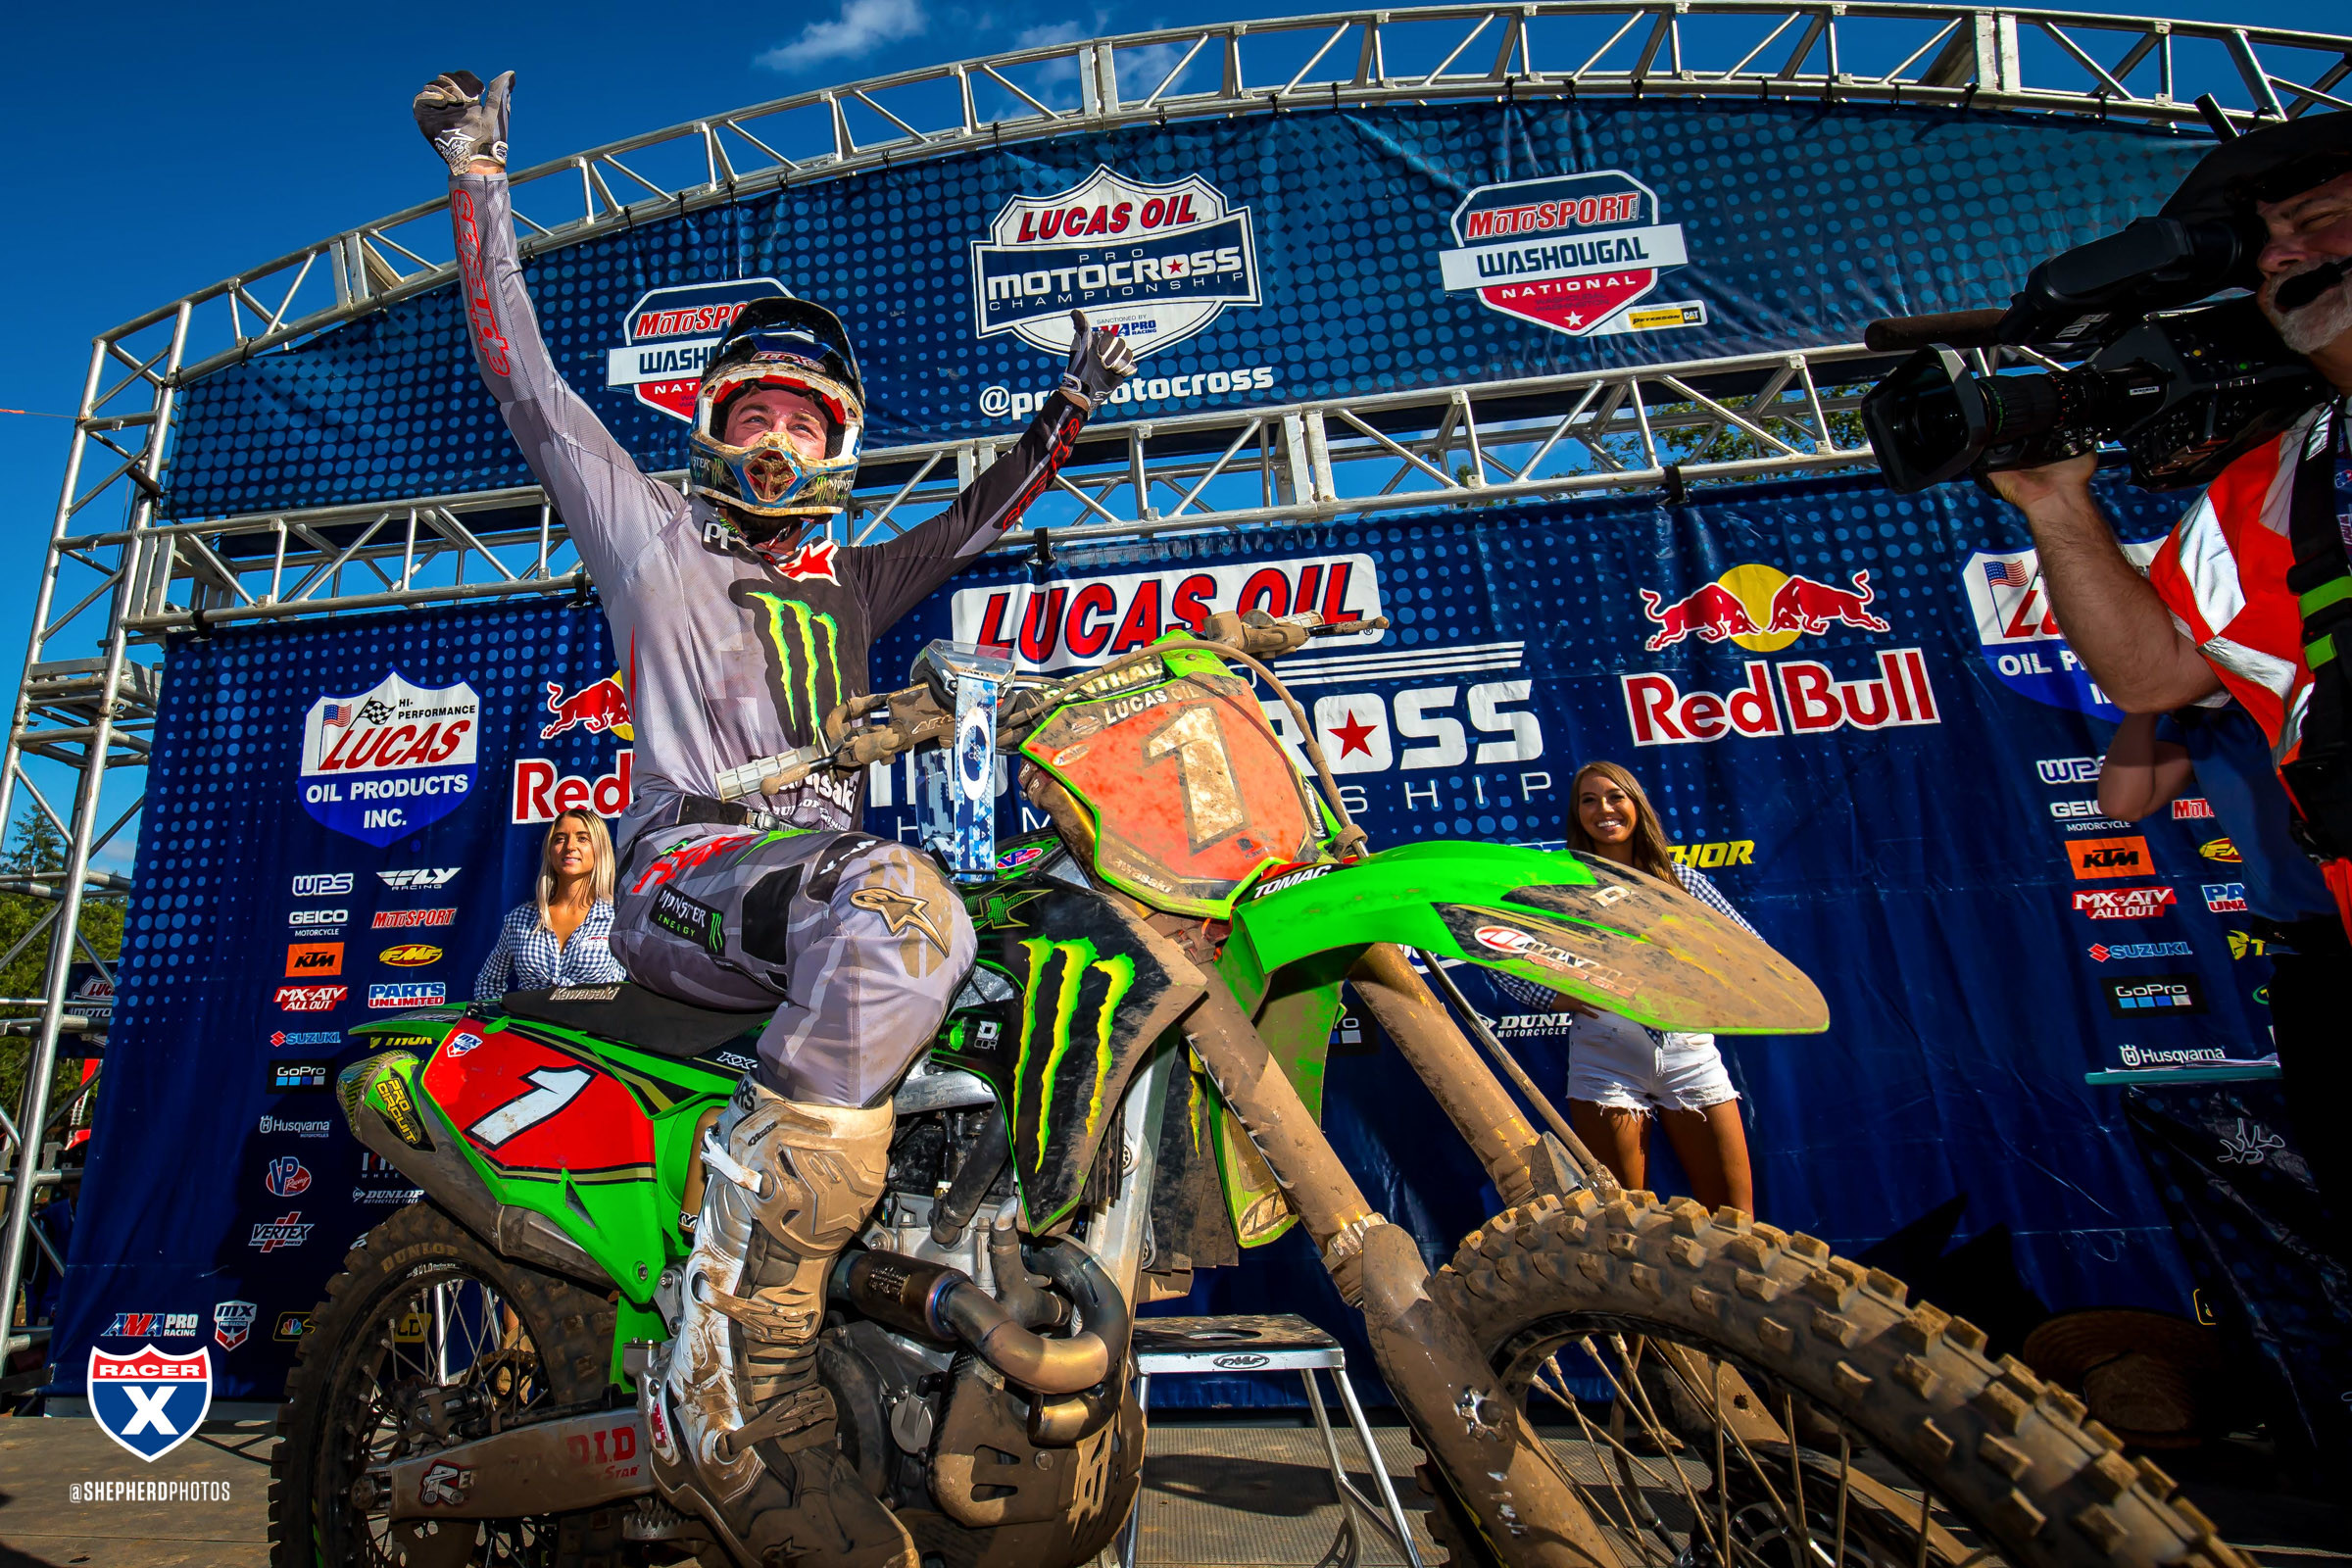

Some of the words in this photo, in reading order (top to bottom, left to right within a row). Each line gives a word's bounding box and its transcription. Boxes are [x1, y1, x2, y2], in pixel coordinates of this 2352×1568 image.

[1016, 202, 1133, 243] LUCAS
[1141, 194, 1198, 228] OIL
[1079, 248, 1144, 263] PRO
[1477, 236, 1649, 278] WASHOUGAL
[987, 246, 1243, 300] MOTOCROSS
[989, 271, 1244, 313] CHAMPIONSHIP
[1500, 275, 1637, 299] NATIONAL
[1096, 315, 1137, 325] SANCTIONED
[1130, 319, 1156, 330] PRO
[1633, 314, 1681, 325] PETERSON
[1683, 310, 1699, 320] CAT
[980, 367, 1275, 419] @protocross
[976, 573, 1218, 664] LUCAS
[1236, 562, 1365, 627] OIL
[1997, 653, 2052, 676] OIL
[398, 698, 414, 708] HI-
[1621, 661, 1785, 747] Red
[1776, 647, 1941, 734] Bull
[397, 705, 476, 719] PERFORMANCE
[1103, 688, 1168, 726] LUCAS
[318, 719, 471, 770] LUCAS
[513, 749, 634, 824] Red
[1144, 704, 1248, 851] 1
[306, 783, 342, 804] OIL
[350, 773, 468, 801] PRODUCTS
[363, 808, 408, 829] INC.
[2066, 820, 2132, 832] MOTORCYCLE
[2082, 848, 2138, 868] KTM
[292, 872, 354, 897] WPS
[375, 867, 463, 887] FLY
[1253, 864, 1332, 900] TOMAC
[2075, 891, 2115, 909] MX
[2124, 888, 2173, 906] ATV
[289, 909, 349, 924] GEICO
[659, 890, 707, 928] MONSTER
[2090, 906, 2124, 919] ALL
[2125, 905, 2158, 916] OUT
[295, 928, 339, 937] MOTORCYCLE
[658, 913, 696, 937] ENERGY
[294, 951, 336, 968] KTM
[379, 946, 443, 963] FMF
[2109, 941, 2192, 959] SUZUKI
[275, 987, 310, 1003] MX
[312, 986, 348, 1001] ATV
[369, 982, 445, 998] PARTS
[549, 986, 620, 1001] Kawasaki
[2115, 983, 2187, 998] GoPro
[283, 1001, 311, 1010] ALL
[310, 1000, 333, 1009] OUT
[368, 997, 444, 1007] UNLIMITED
[1498, 1012, 1573, 1029] DUNL
[285, 1032, 341, 1045] SUZUKI
[1496, 1027, 1568, 1039] MOTORCYCLE
[2140, 1046, 2227, 1064] Husqvarna
[276, 1066, 326, 1076] GoPro
[388, 1079, 411, 1113] PRO
[376, 1082, 418, 1145] CIRCUIT
[466, 1066, 595, 1149] 1
[272, 1118, 330, 1133] Husqvarna
[269, 1156, 300, 1196] VP
[365, 1189, 425, 1199] DUNLOP
[251, 1223, 316, 1241] VERTEX
[380, 1242, 459, 1274] DUNLOP
[100, 1312, 166, 1338] AMA
[165, 1313, 199, 1329] PRO
[164, 1328, 196, 1338] RACING
